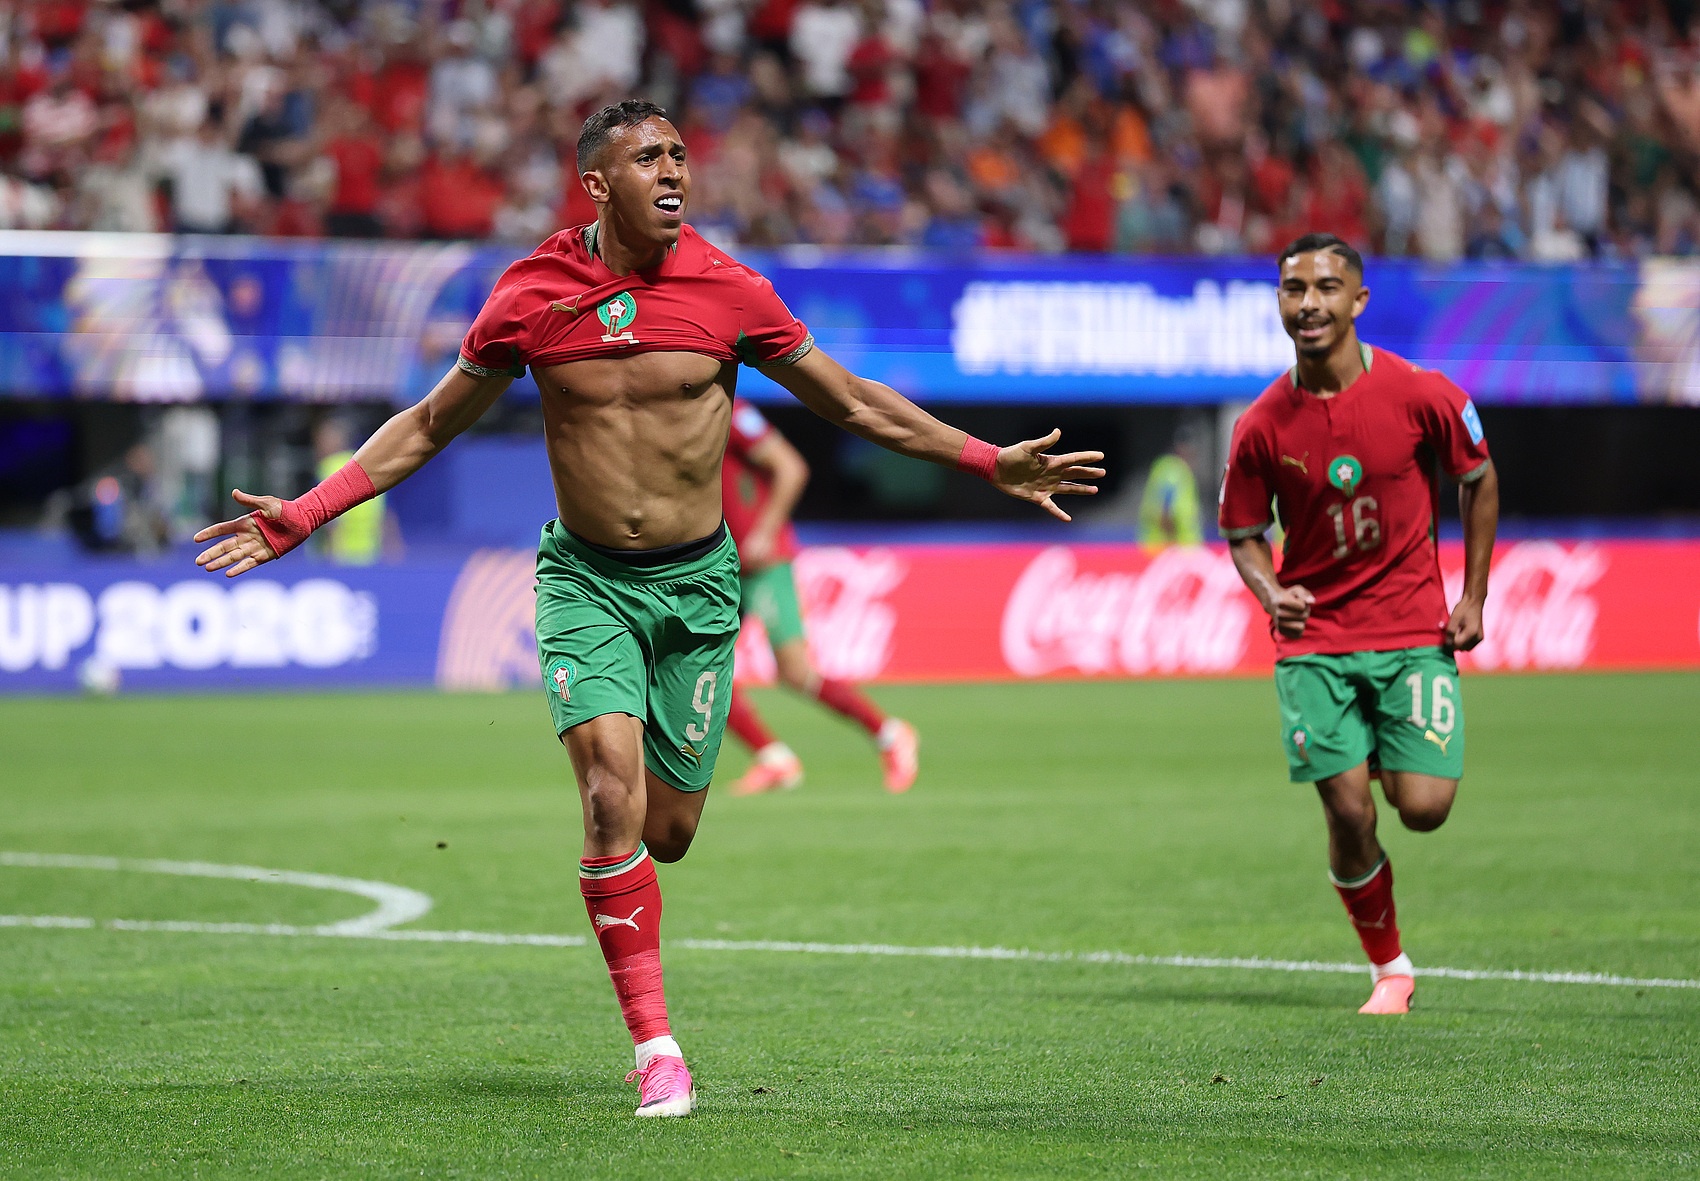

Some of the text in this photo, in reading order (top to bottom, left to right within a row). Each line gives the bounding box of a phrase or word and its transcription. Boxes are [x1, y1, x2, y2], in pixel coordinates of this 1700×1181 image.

[1326, 496, 1380, 559] 16
[685, 671, 717, 741] 9
[1405, 671, 1455, 734] 16
